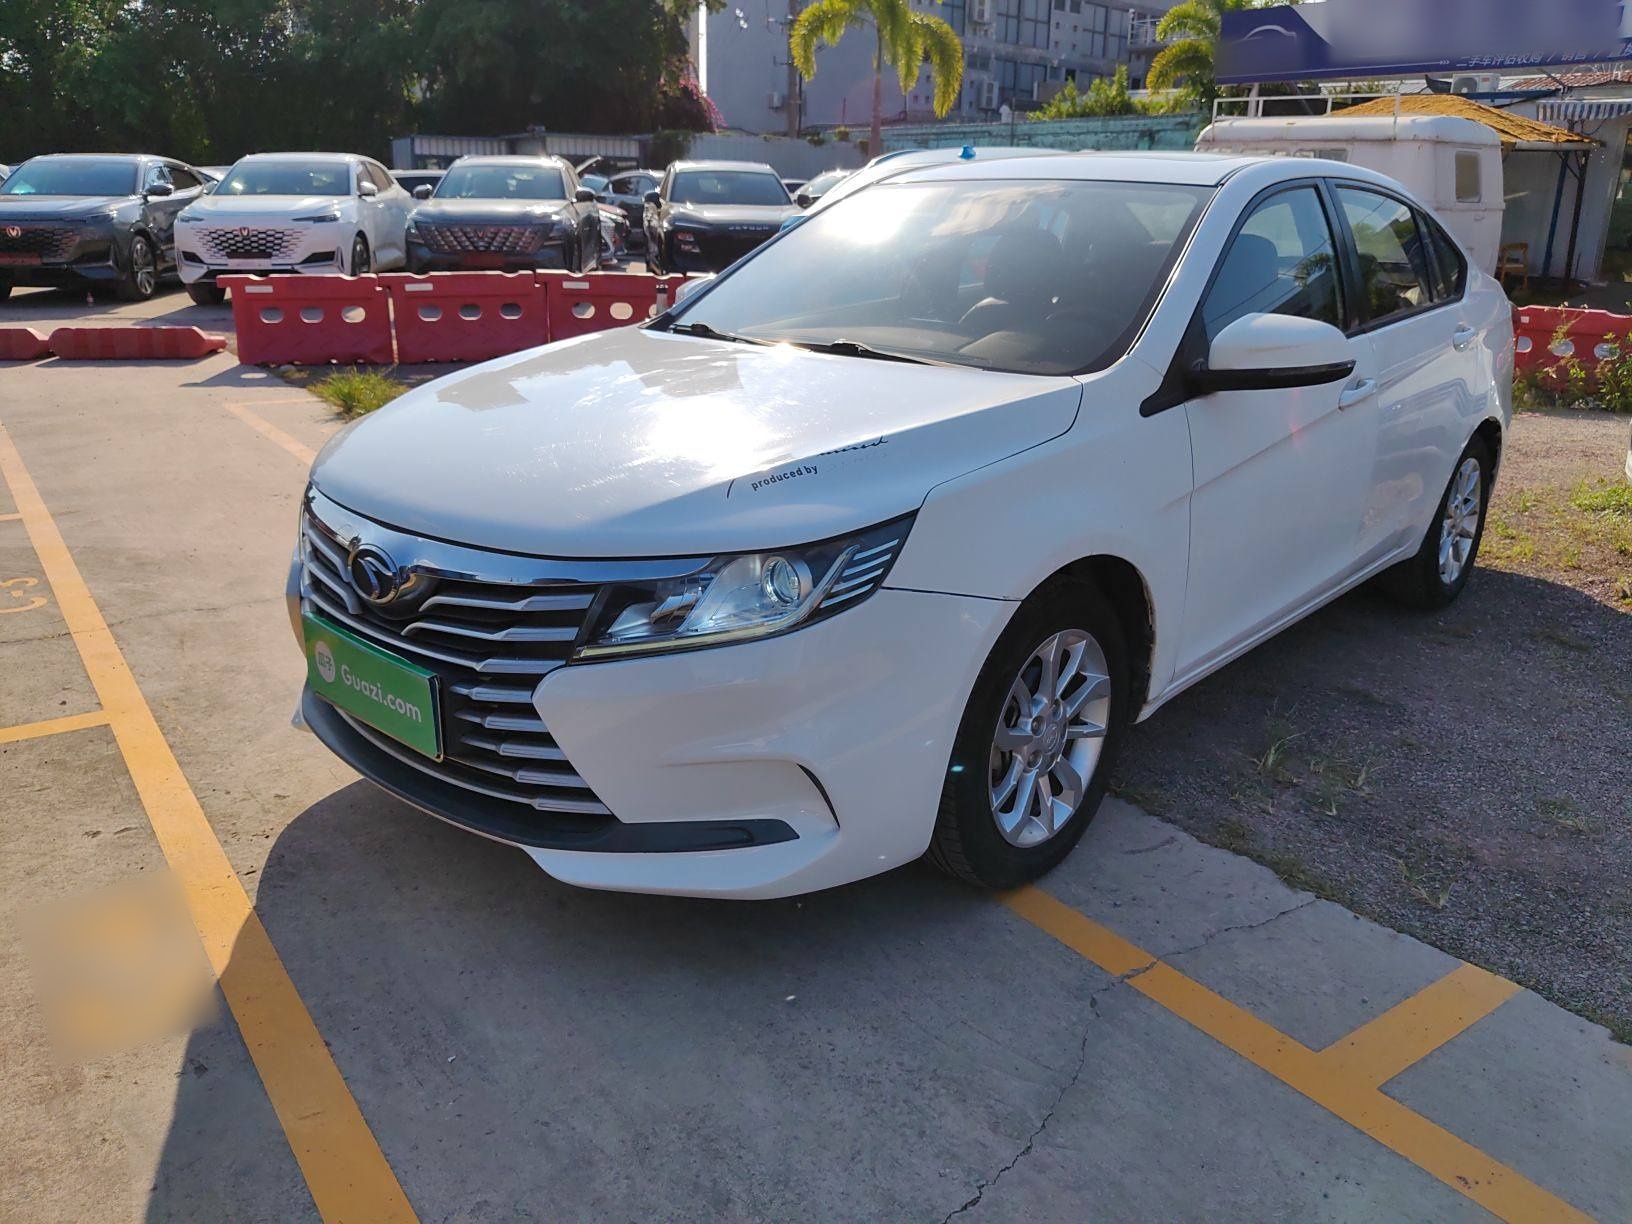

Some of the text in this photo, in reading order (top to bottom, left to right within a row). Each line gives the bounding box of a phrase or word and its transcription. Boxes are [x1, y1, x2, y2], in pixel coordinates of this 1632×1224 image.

[751, 464, 818, 491] produced by
[341, 664, 422, 723] Guazi.com
